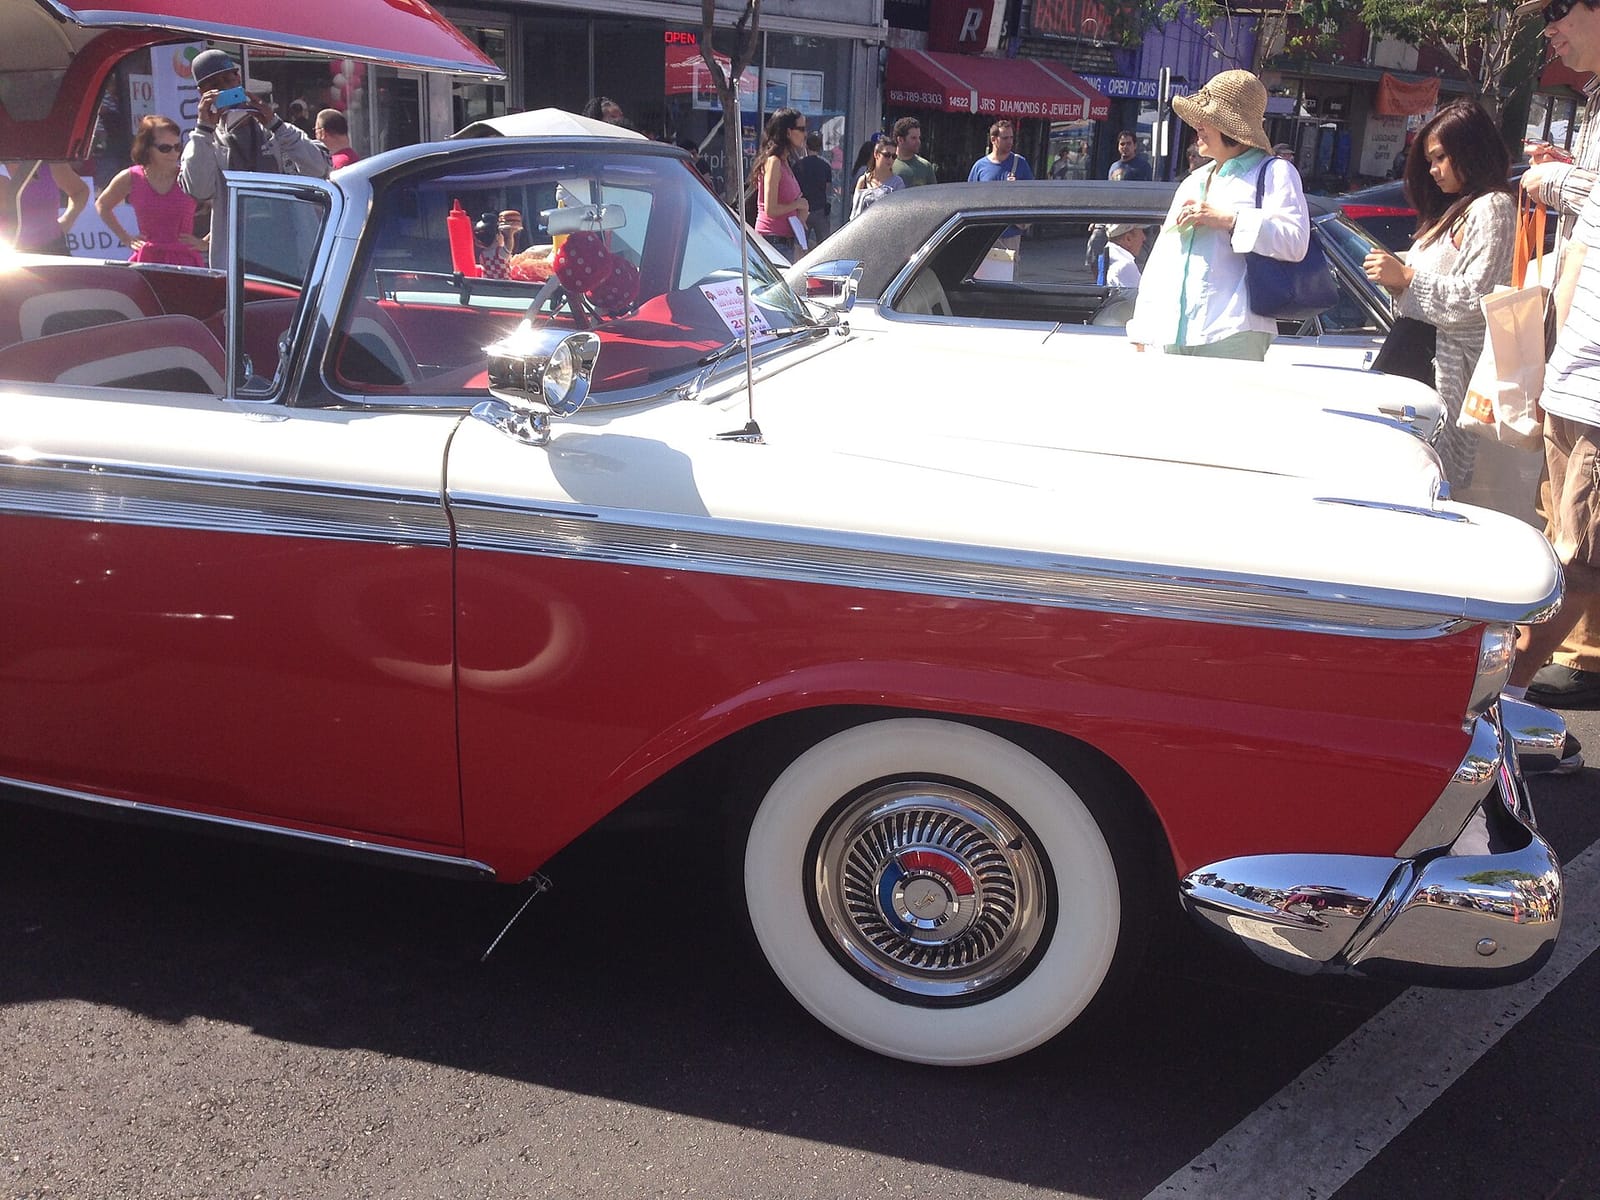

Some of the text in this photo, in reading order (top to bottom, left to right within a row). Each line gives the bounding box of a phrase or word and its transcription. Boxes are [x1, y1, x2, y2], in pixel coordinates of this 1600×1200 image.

[959, 8, 983, 42] R
[665, 31, 696, 44] OPEN
[1109, 79, 1130, 95] OPEN
[1130, 81, 1137, 95] 7
[1137, 82, 1157, 97] DAYS
[949, 96, 969, 107] 14522
[1000, 99, 1040, 114] DIAMONDS
[1041, 102, 1048, 115] &
[1049, 102, 1082, 116] JEWELRY
[1091, 106, 1108, 116] 14522
[66, 231, 126, 251] BUD
